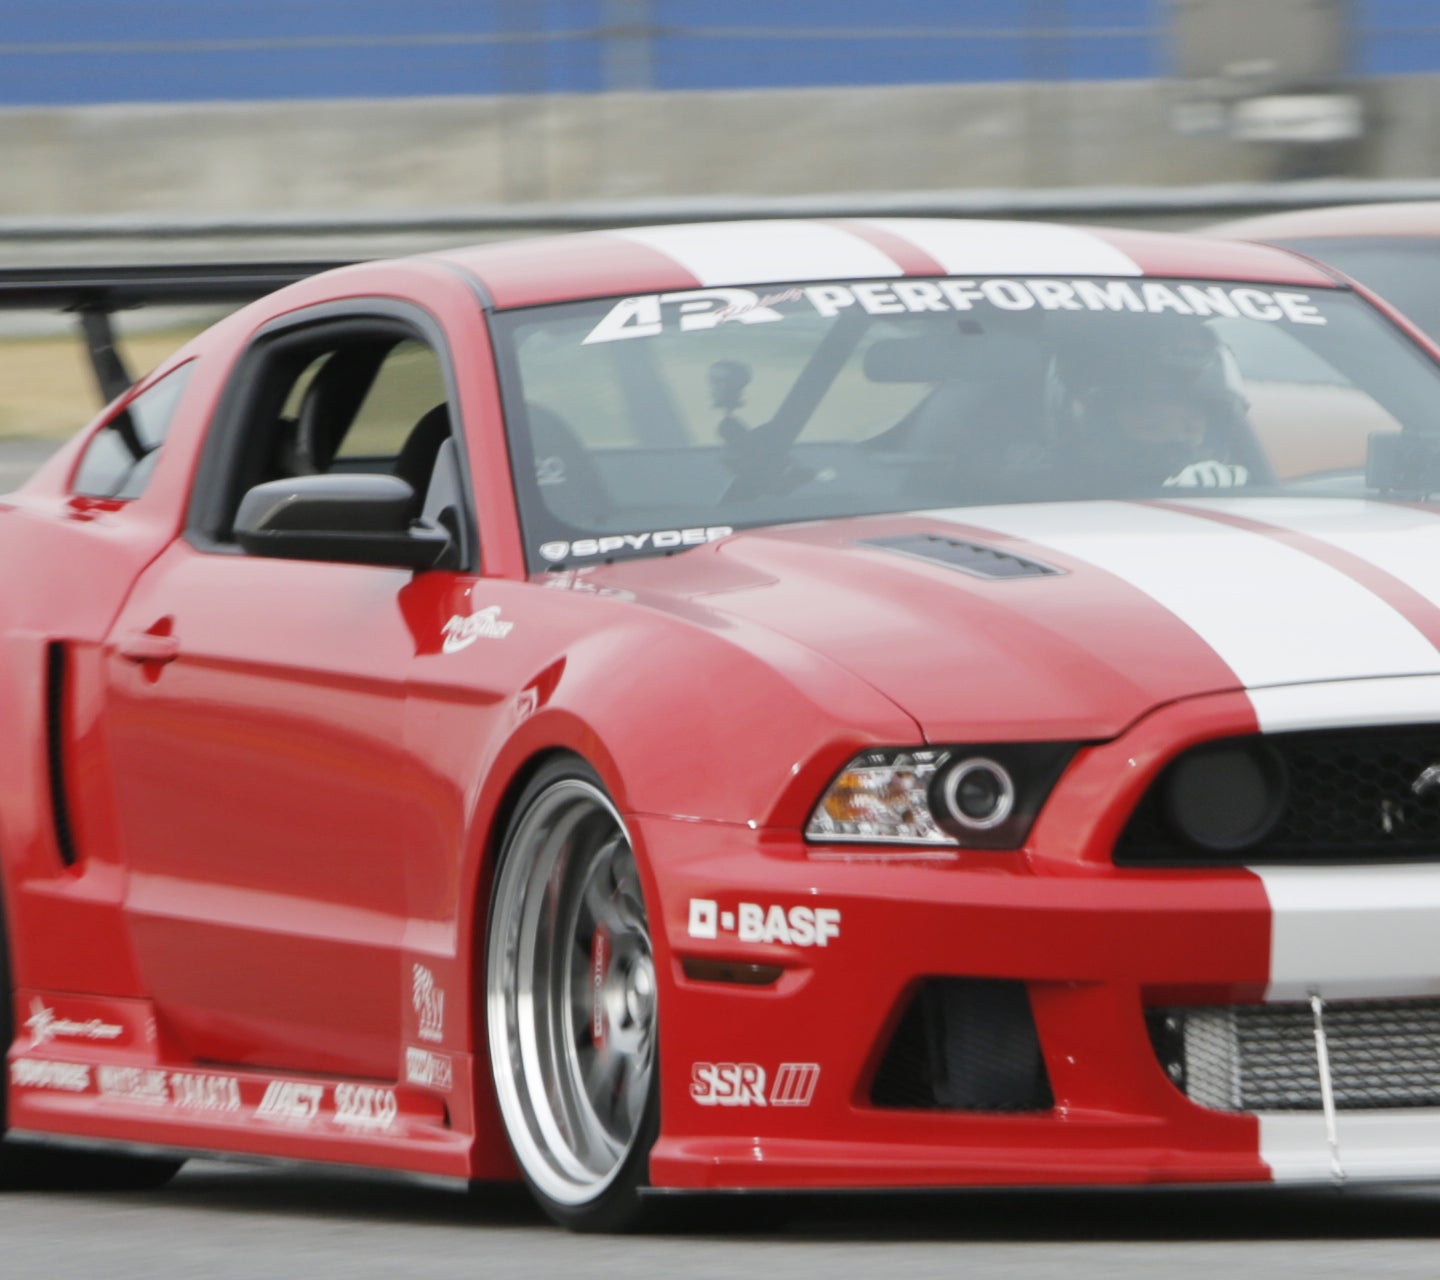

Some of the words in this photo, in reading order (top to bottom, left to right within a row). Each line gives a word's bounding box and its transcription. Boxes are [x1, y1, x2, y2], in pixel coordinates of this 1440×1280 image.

[804, 279, 1327, 325] PERFORMANCE
[571, 526, 733, 556] SPYDER
[738, 902, 841, 947] BASF
[690, 1062, 767, 1107] SSR
